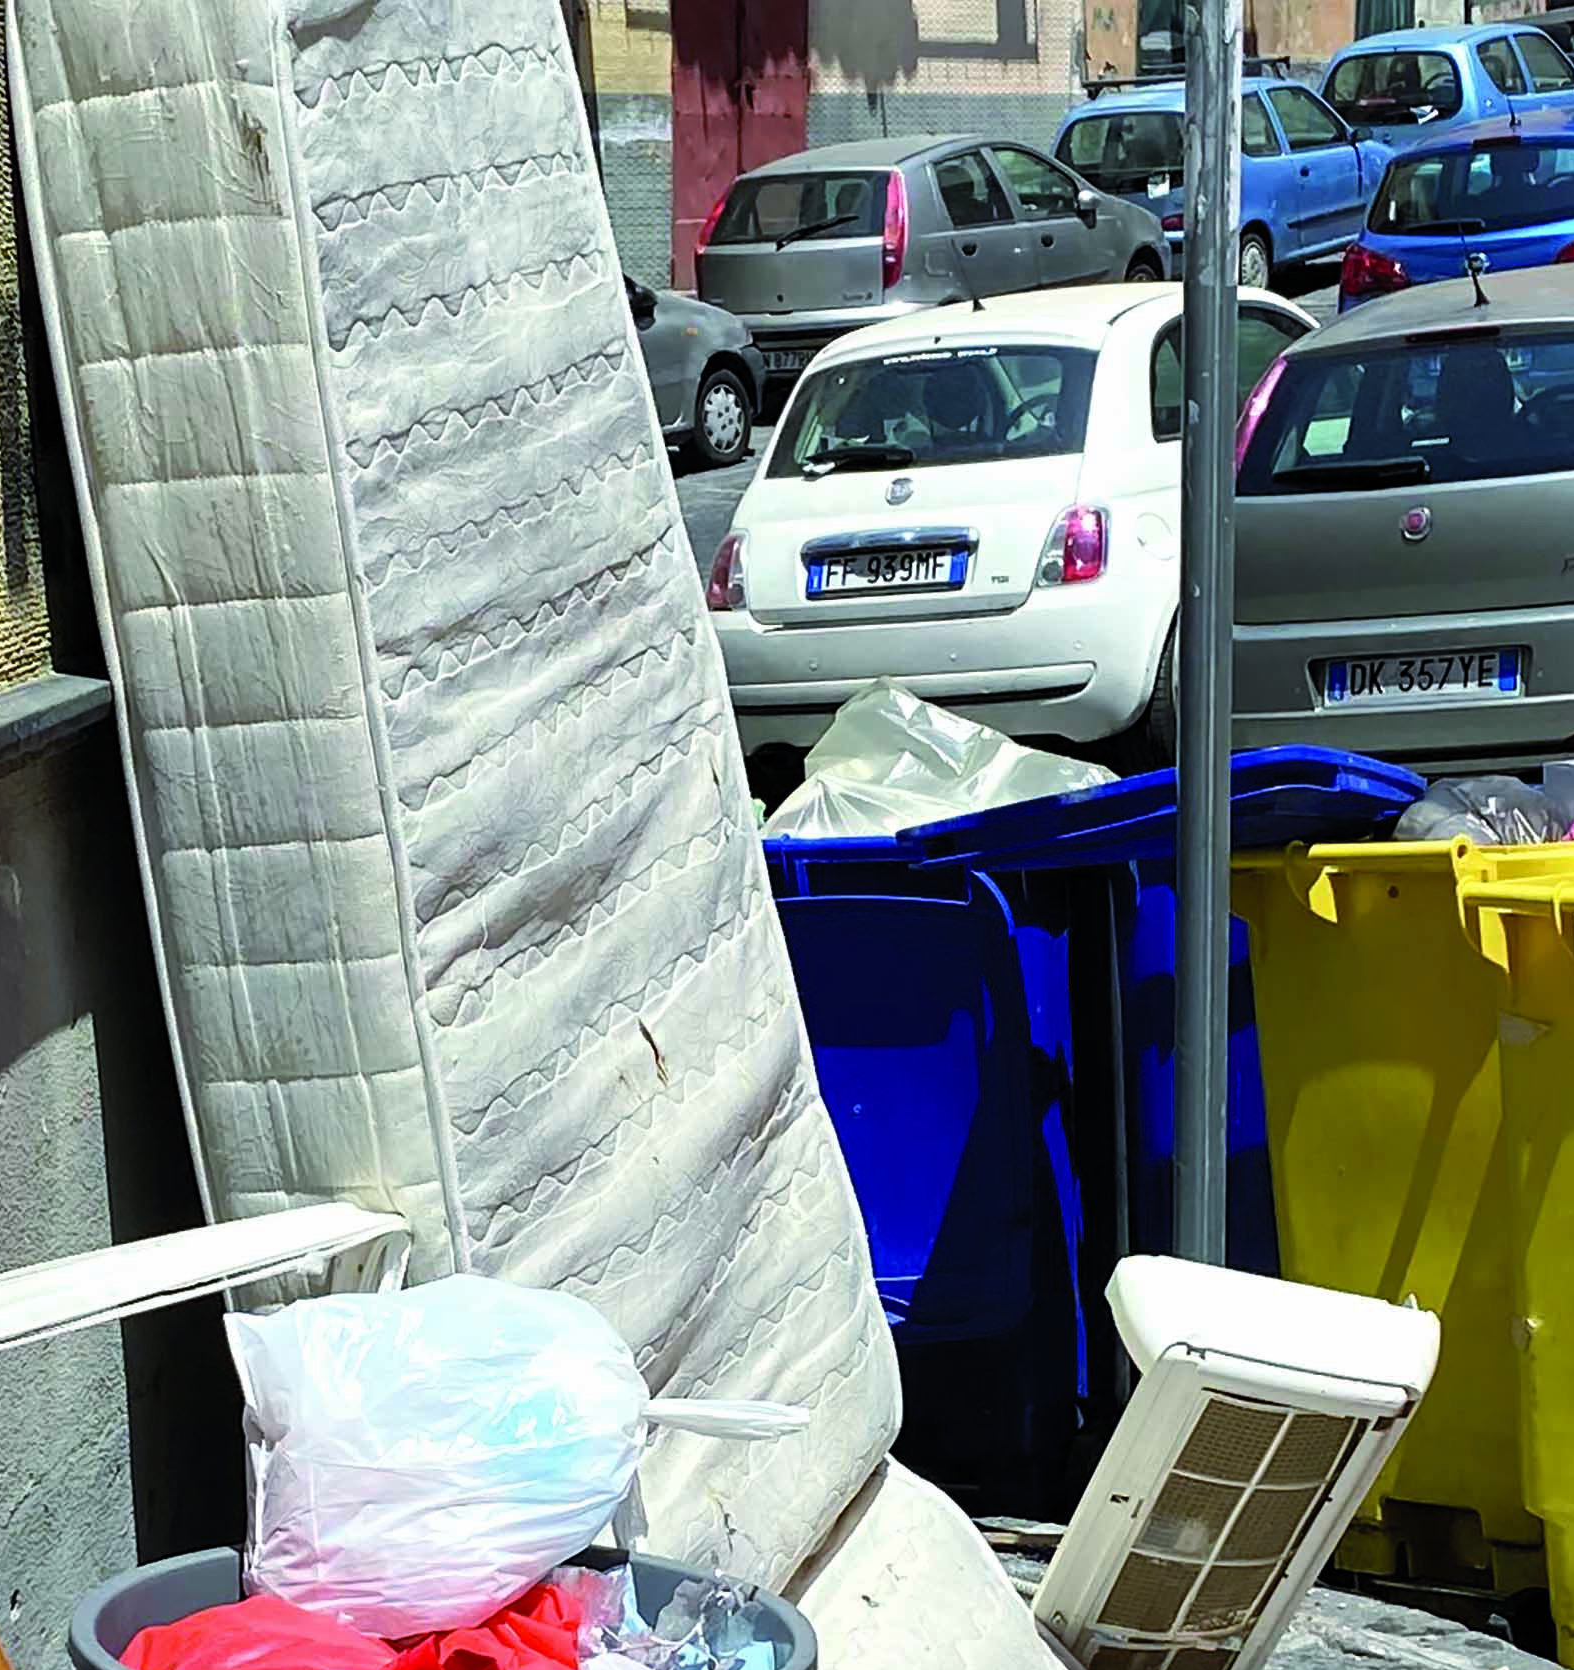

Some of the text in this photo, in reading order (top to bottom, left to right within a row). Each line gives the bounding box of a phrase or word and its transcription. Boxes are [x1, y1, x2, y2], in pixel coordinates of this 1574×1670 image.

[826, 557, 857, 588] FF
[867, 551, 947, 584] 939MF
[1350, 660, 1386, 696] DK
[1397, 653, 1497, 693] 357YE
